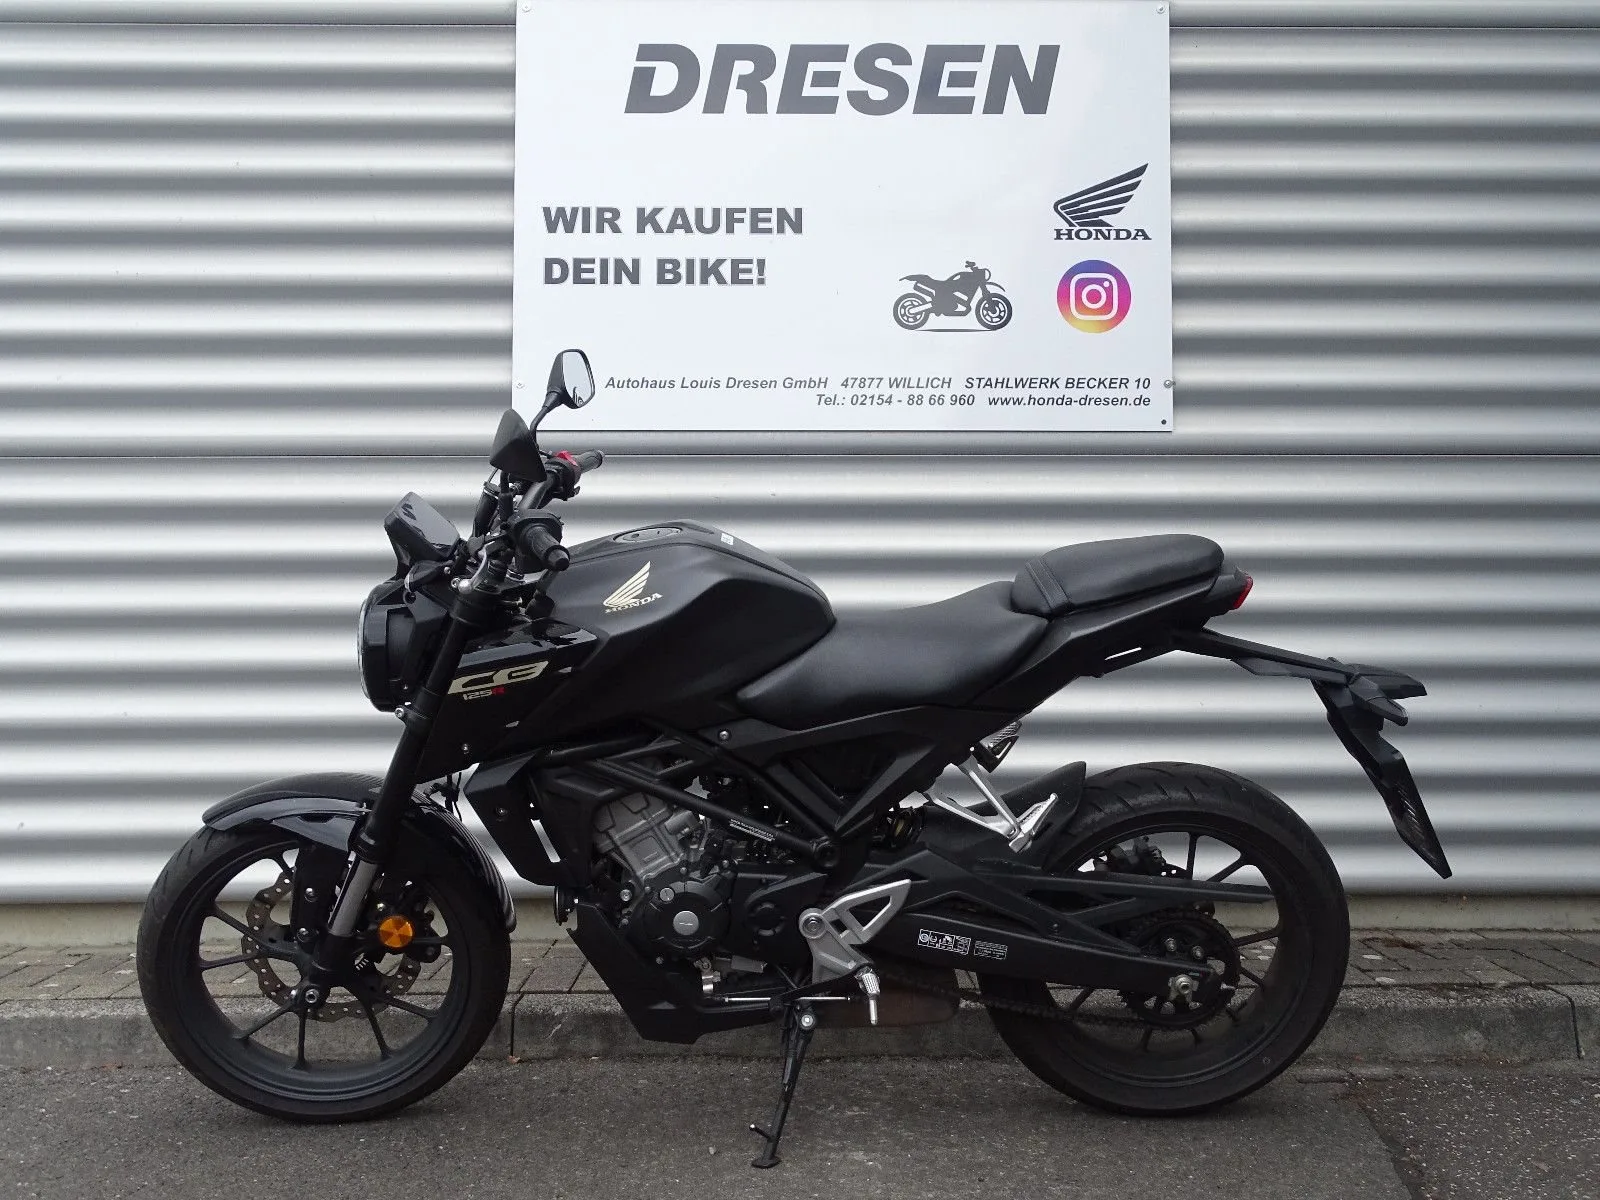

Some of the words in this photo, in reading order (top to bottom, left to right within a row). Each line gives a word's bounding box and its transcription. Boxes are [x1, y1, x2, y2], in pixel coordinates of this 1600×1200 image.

[624, 43, 1060, 115] DRESEN
[542, 206, 622, 235] WIR
[636, 206, 804, 235] KAUFEN
[1053, 226, 1153, 241] HONDA
[543, 257, 641, 286] DEIN
[656, 257, 767, 287] BIKE!
[604, 376, 676, 390] Autohaus
[680, 376, 721, 390] Louis
[725, 376, 778, 390] Dresen
[782, 376, 829, 390] GmbH
[840, 376, 884, 390] 47877
[888, 376, 953, 390] WILLICH
[964, 376, 1061, 390] STAHLWERK
[1064, 376, 1130, 390] BECKER
[1134, 377, 1151, 390] 10
[816, 393, 846, 407] Tel.:
[850, 393, 893, 407] 02154
[906, 393, 924, 407] 88
[928, 393, 946, 407] 66
[949, 393, 976, 407] 960
[987, 393, 1151, 407] www.honda-dresen.de
[605, 592, 664, 614] HONDA
[447, 660, 549, 695] CB
[463, 685, 505, 701] 125R
